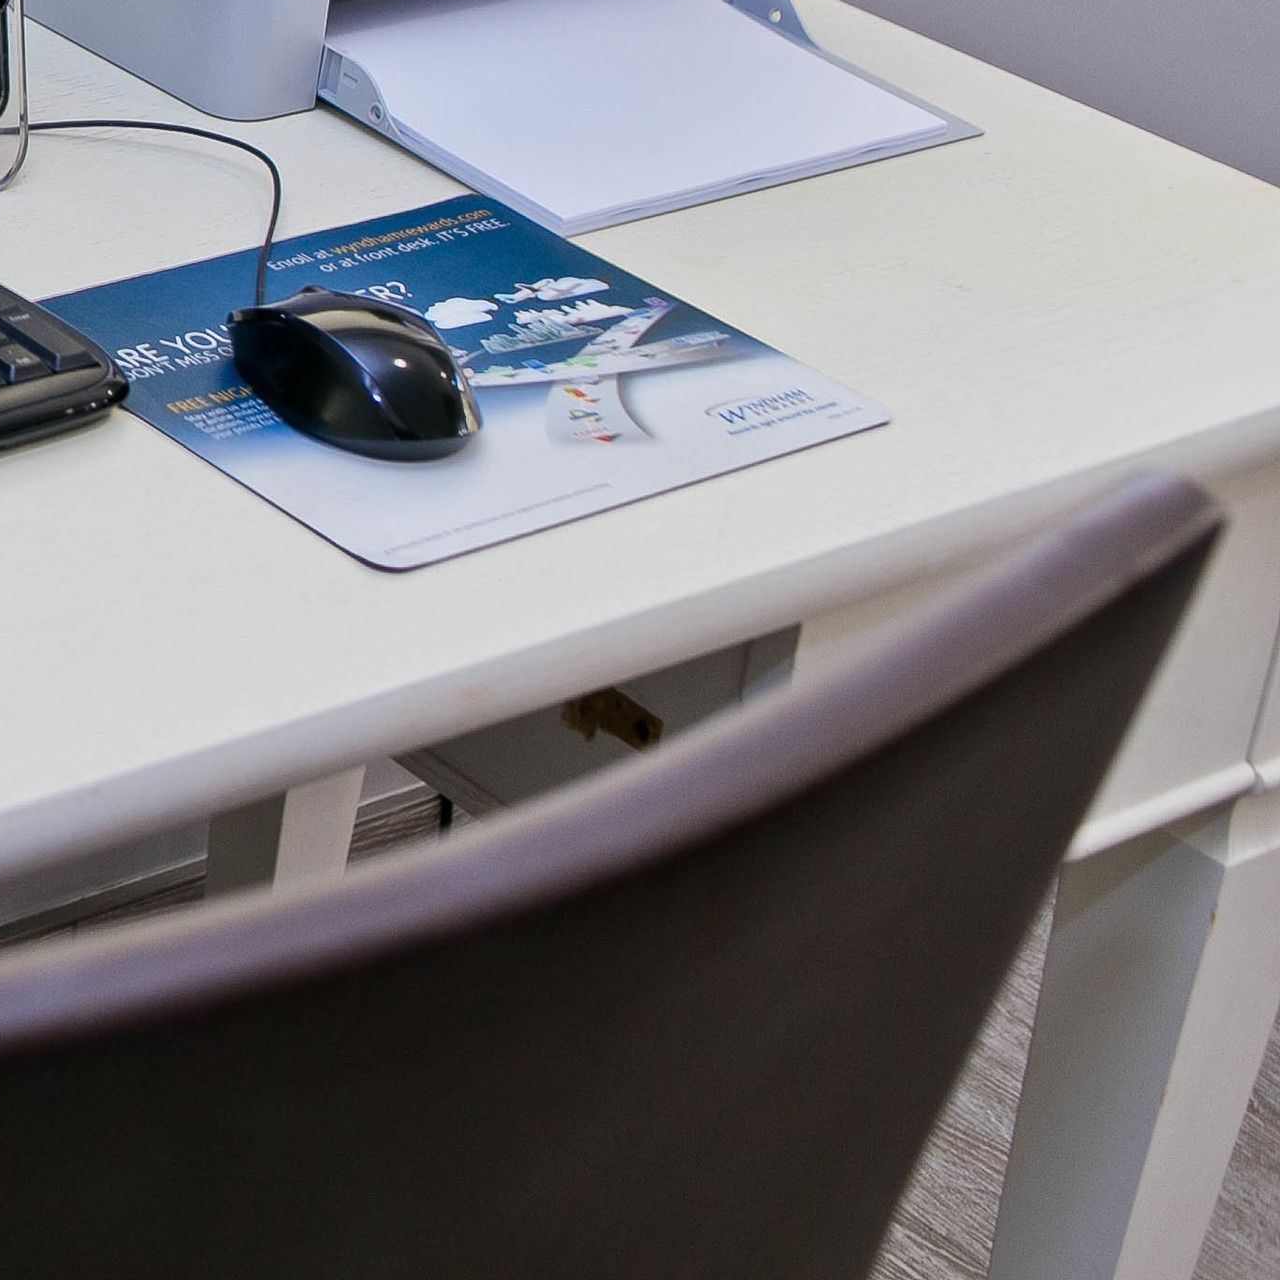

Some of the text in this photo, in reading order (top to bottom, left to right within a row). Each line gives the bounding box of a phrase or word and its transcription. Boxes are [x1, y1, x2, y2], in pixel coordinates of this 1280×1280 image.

[267, 208, 494, 272] Enroll at wyndhamrewards.com
[319, 260, 338, 273] or
[341, 255, 360, 270] at
[358, 245, 397, 264] front
[437, 224, 469, 243] IT'S
[465, 217, 511, 238] FREE.
[175, 350, 221, 369] MISS
